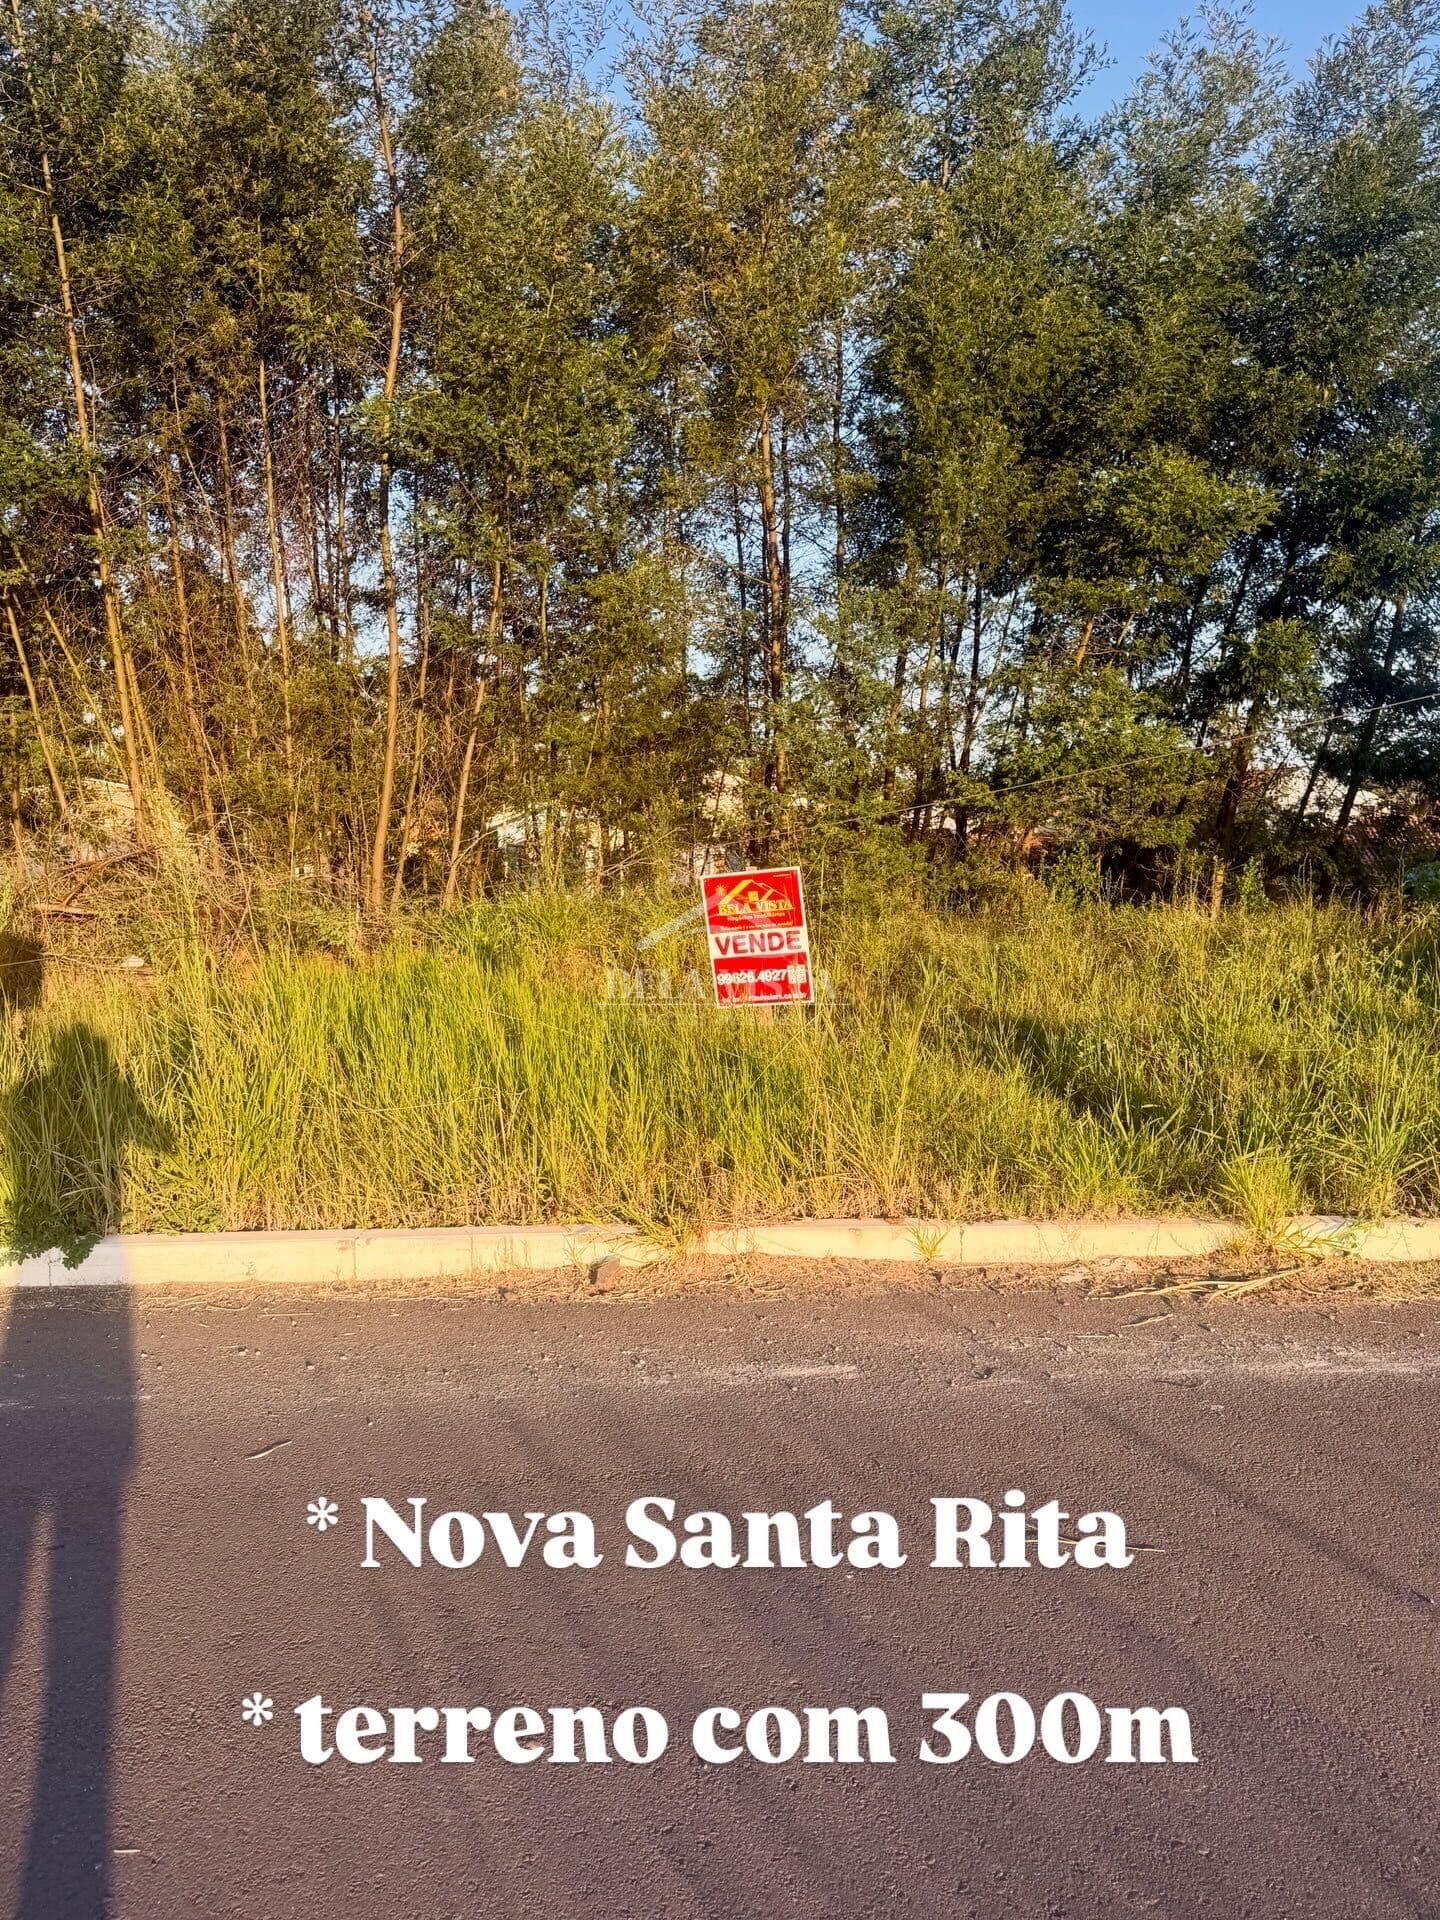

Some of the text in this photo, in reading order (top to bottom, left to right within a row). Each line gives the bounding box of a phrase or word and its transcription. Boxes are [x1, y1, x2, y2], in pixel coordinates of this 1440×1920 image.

[718, 901, 753, 915] BELA
[755, 899, 793, 912] VISTA
[715, 931, 802, 955] VENDE
